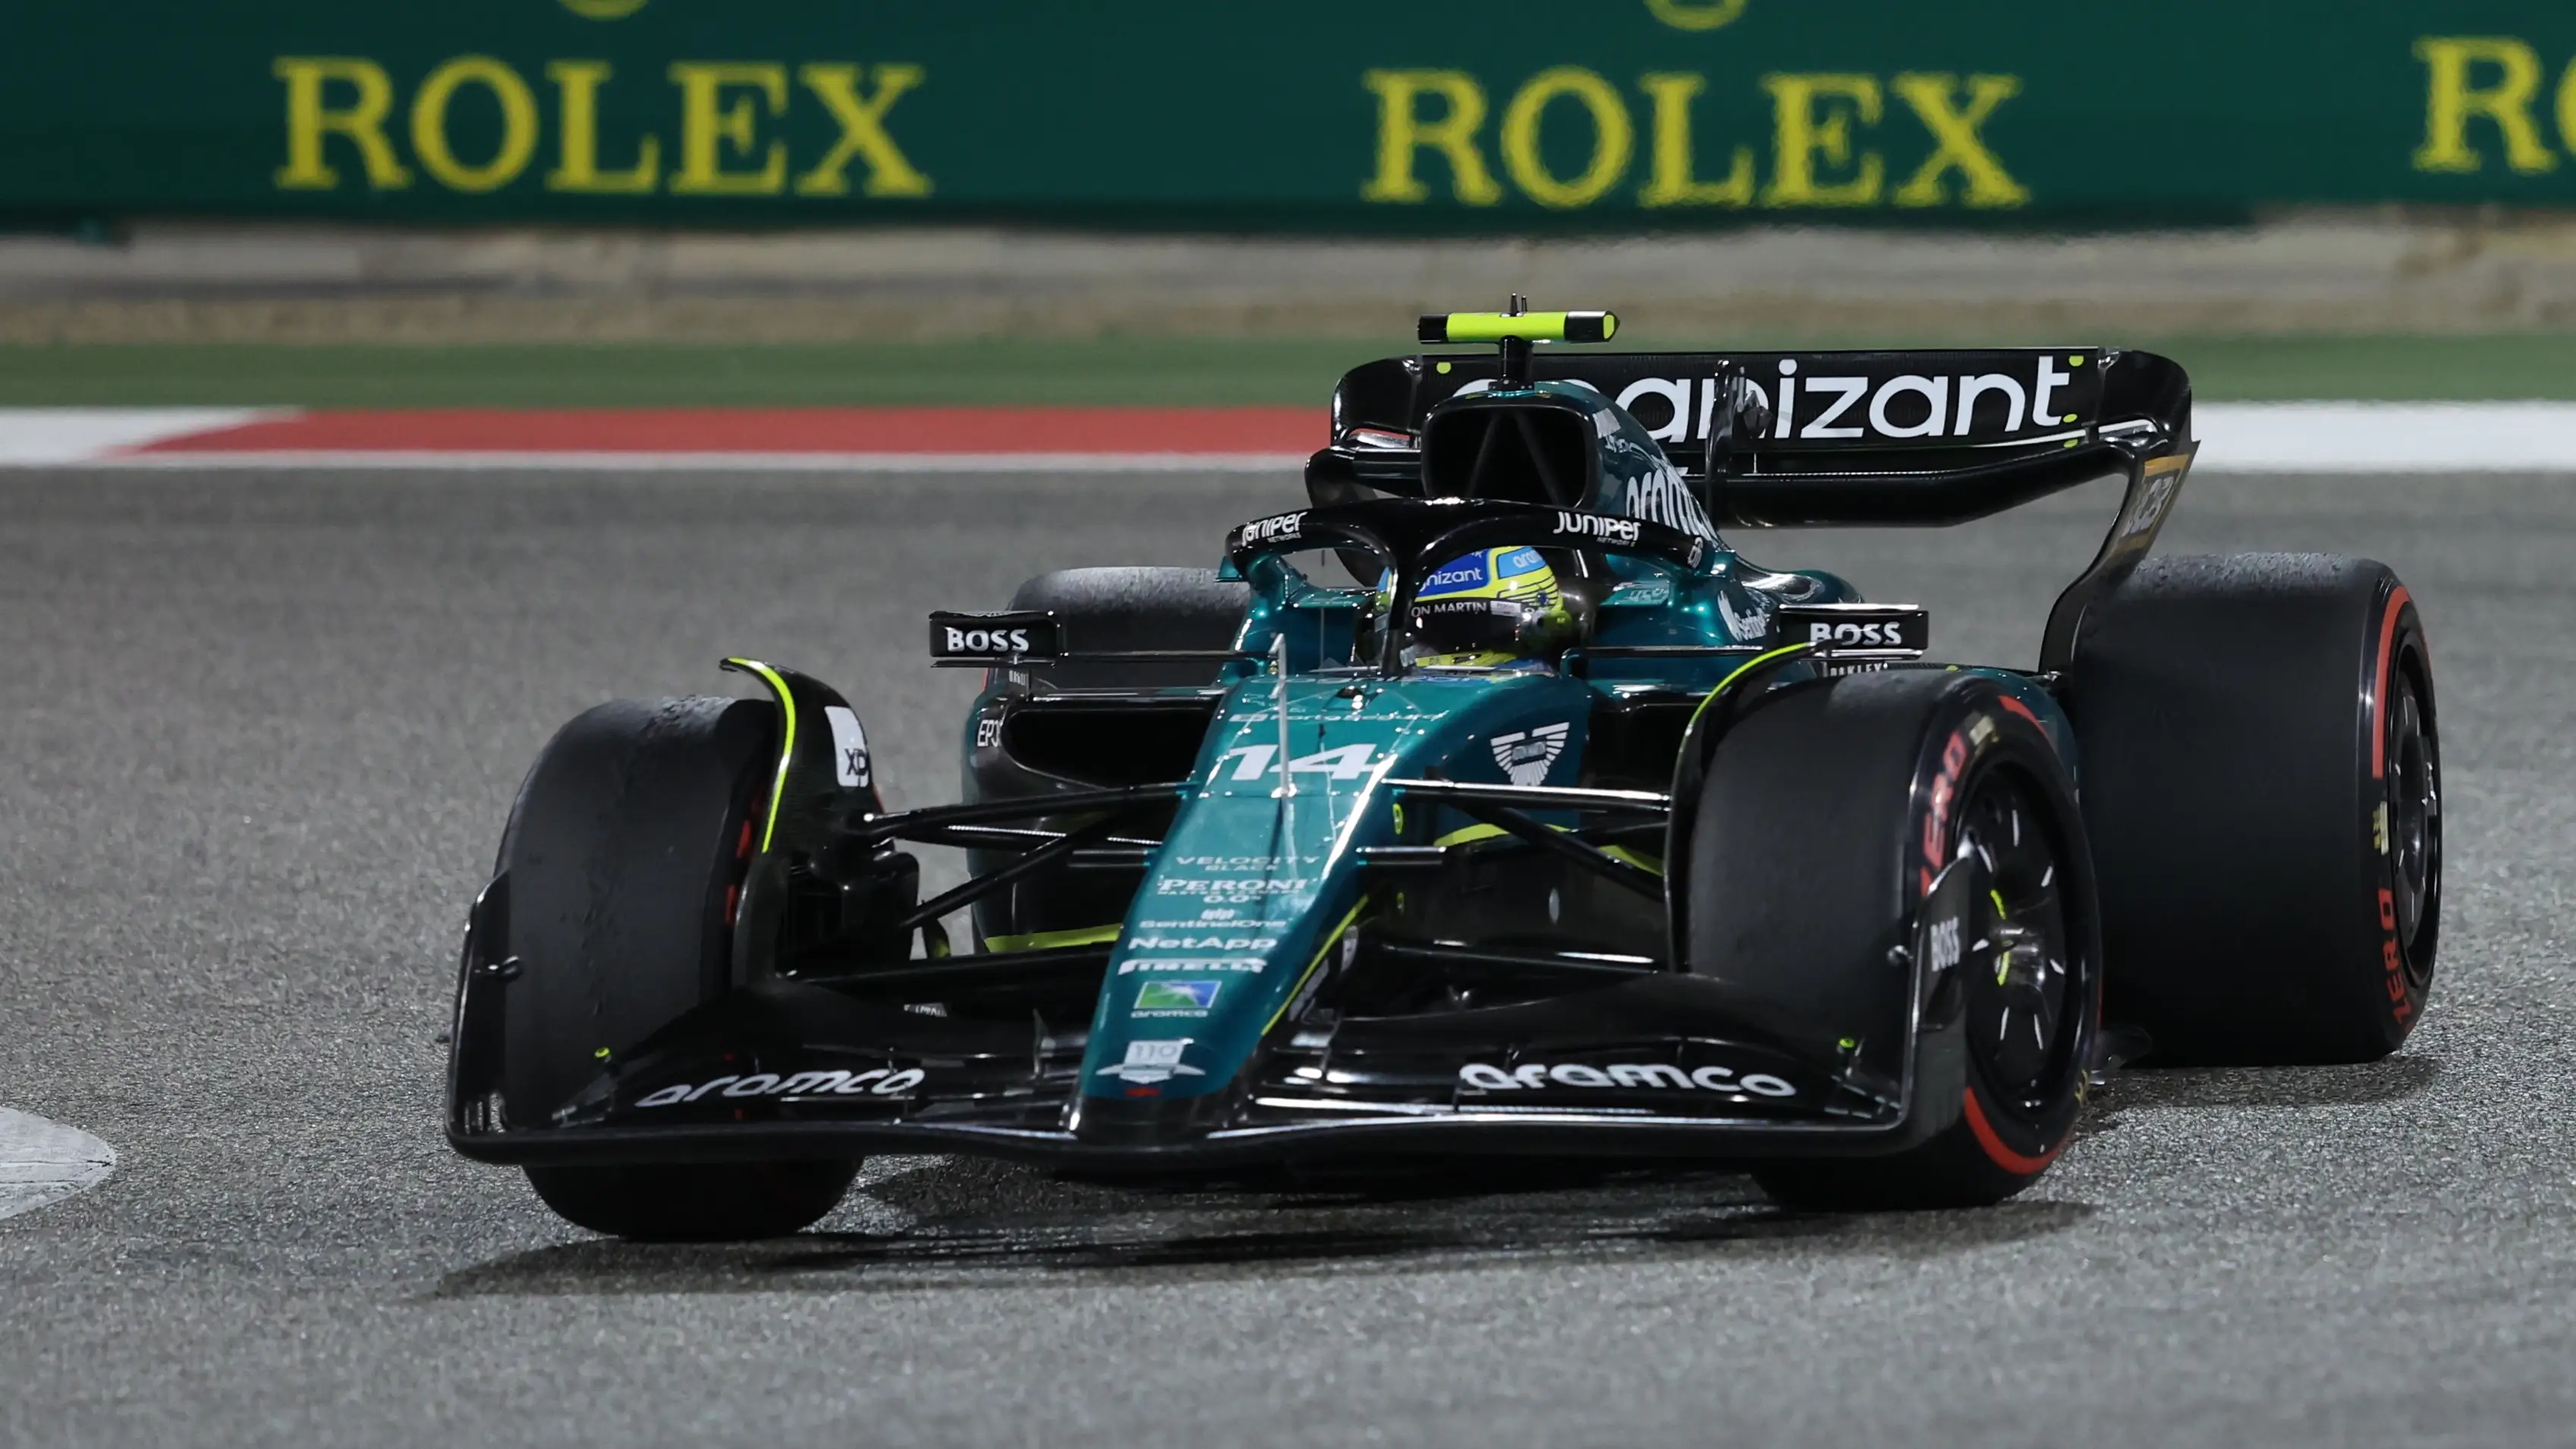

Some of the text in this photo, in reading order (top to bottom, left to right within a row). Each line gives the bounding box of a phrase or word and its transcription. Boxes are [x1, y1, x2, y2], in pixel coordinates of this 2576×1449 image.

[2411, 36, 2576, 174] R
[275, 56, 932, 196] ROLEX
[1363, 67, 2030, 208] ROLEX
[1433, 602, 1487, 614] MARTIN
[946, 628, 1030, 652] BOSS
[1810, 621, 1902, 646] BOSS
[1228, 743, 1378, 780] 14
[1175, 856, 1319, 866] VELOCITY
[1160, 878, 1309, 891] PERONI
[1139, 920, 1288, 929] SentinelOne
[1128, 937, 1279, 951] NetApp
[1930, 916, 1961, 972] BOSS
[1118, 957, 1268, 976] PIRELLI
[1130, 1010, 1209, 1019] aramco
[635, 1068, 925, 1108] aramco
[1458, 1064, 1797, 1097] aramco
